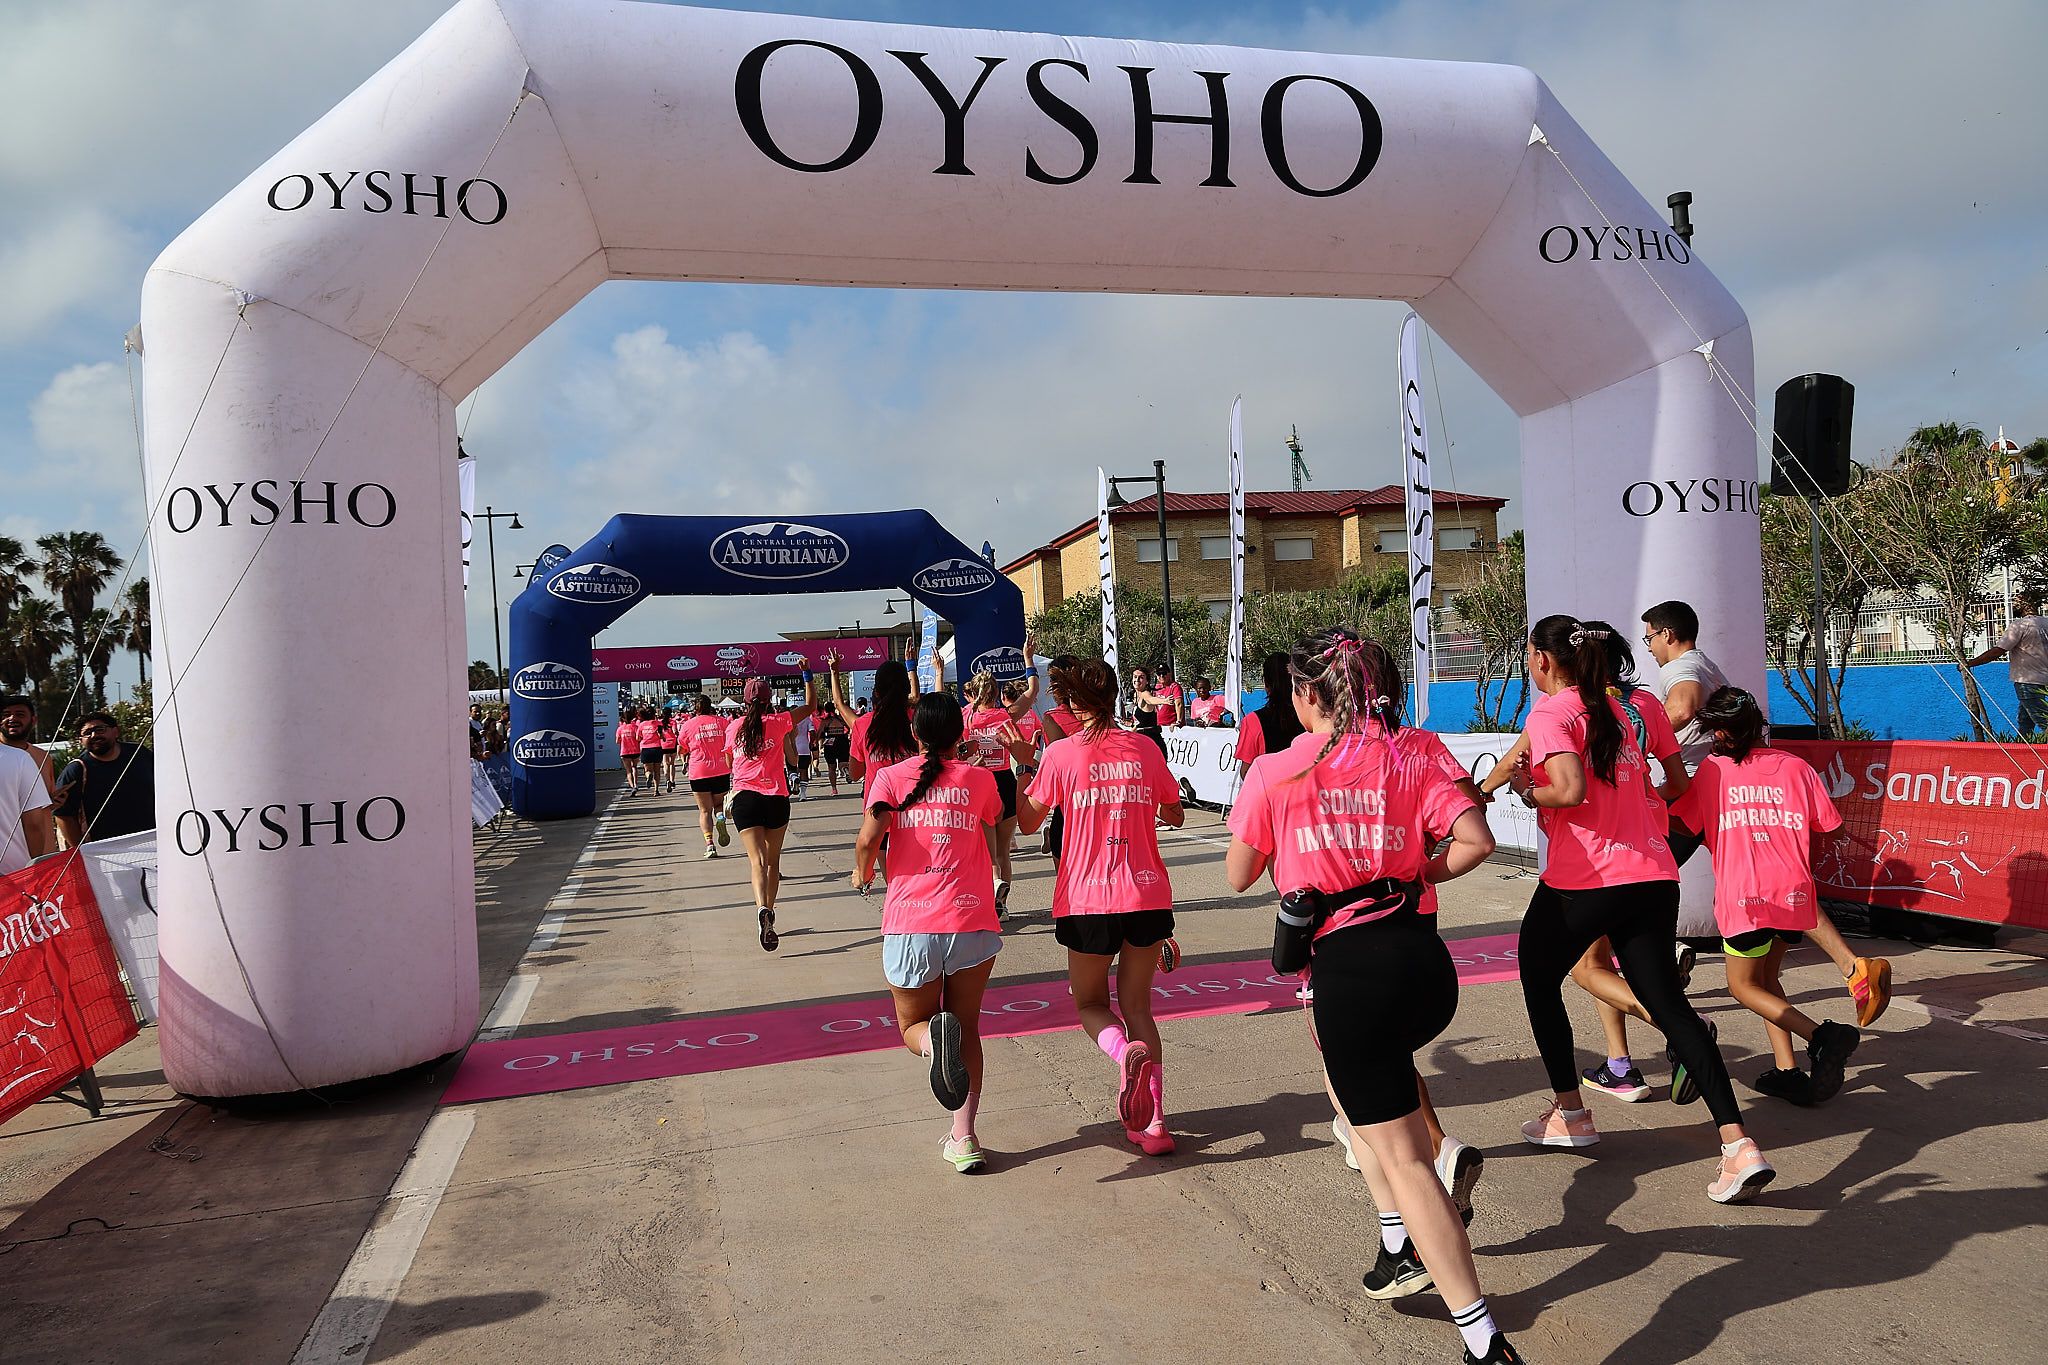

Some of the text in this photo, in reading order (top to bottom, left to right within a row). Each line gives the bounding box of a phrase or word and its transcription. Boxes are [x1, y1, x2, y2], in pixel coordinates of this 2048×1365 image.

[734, 39, 1383, 197] OYSHO
[267, 170, 508, 225] OYSHO
[1538, 225, 1690, 265] OYSHO
[167, 479, 397, 533] OYSHO
[1622, 478, 1759, 517] OYSHO
[742, 538, 835, 546] CENTRAL LECHERA
[721, 540, 840, 565] ASTURIANA
[552, 578, 634, 595] ASTURIANA
[920, 574, 991, 589] ASTURIANA
[976, 661, 1025, 674] ASTURIAN
[516, 676, 580, 690] ASTURIANA
[672, 683, 697, 691] OYSHO
[722, 687, 742, 695] OYS
[469, 693, 501, 703] YSHO
[516, 743, 580, 759] ASTURIANA
[1089, 761, 1143, 782] SOMOS
[916, 786, 970, 806] OMOS
[1728, 785, 1784, 805] SOMOS
[1862, 763, 2048, 810] Santand
[1318, 787, 1387, 816] SOMOS
[175, 796, 406, 857] OYSHO
[1719, 808, 1804, 832] MPARABLES
[932, 833, 951, 844] 2026
[1106, 836, 1129, 846] Sara
[900, 900, 932, 909] OYSHO
[0, 894, 71, 958] ander
